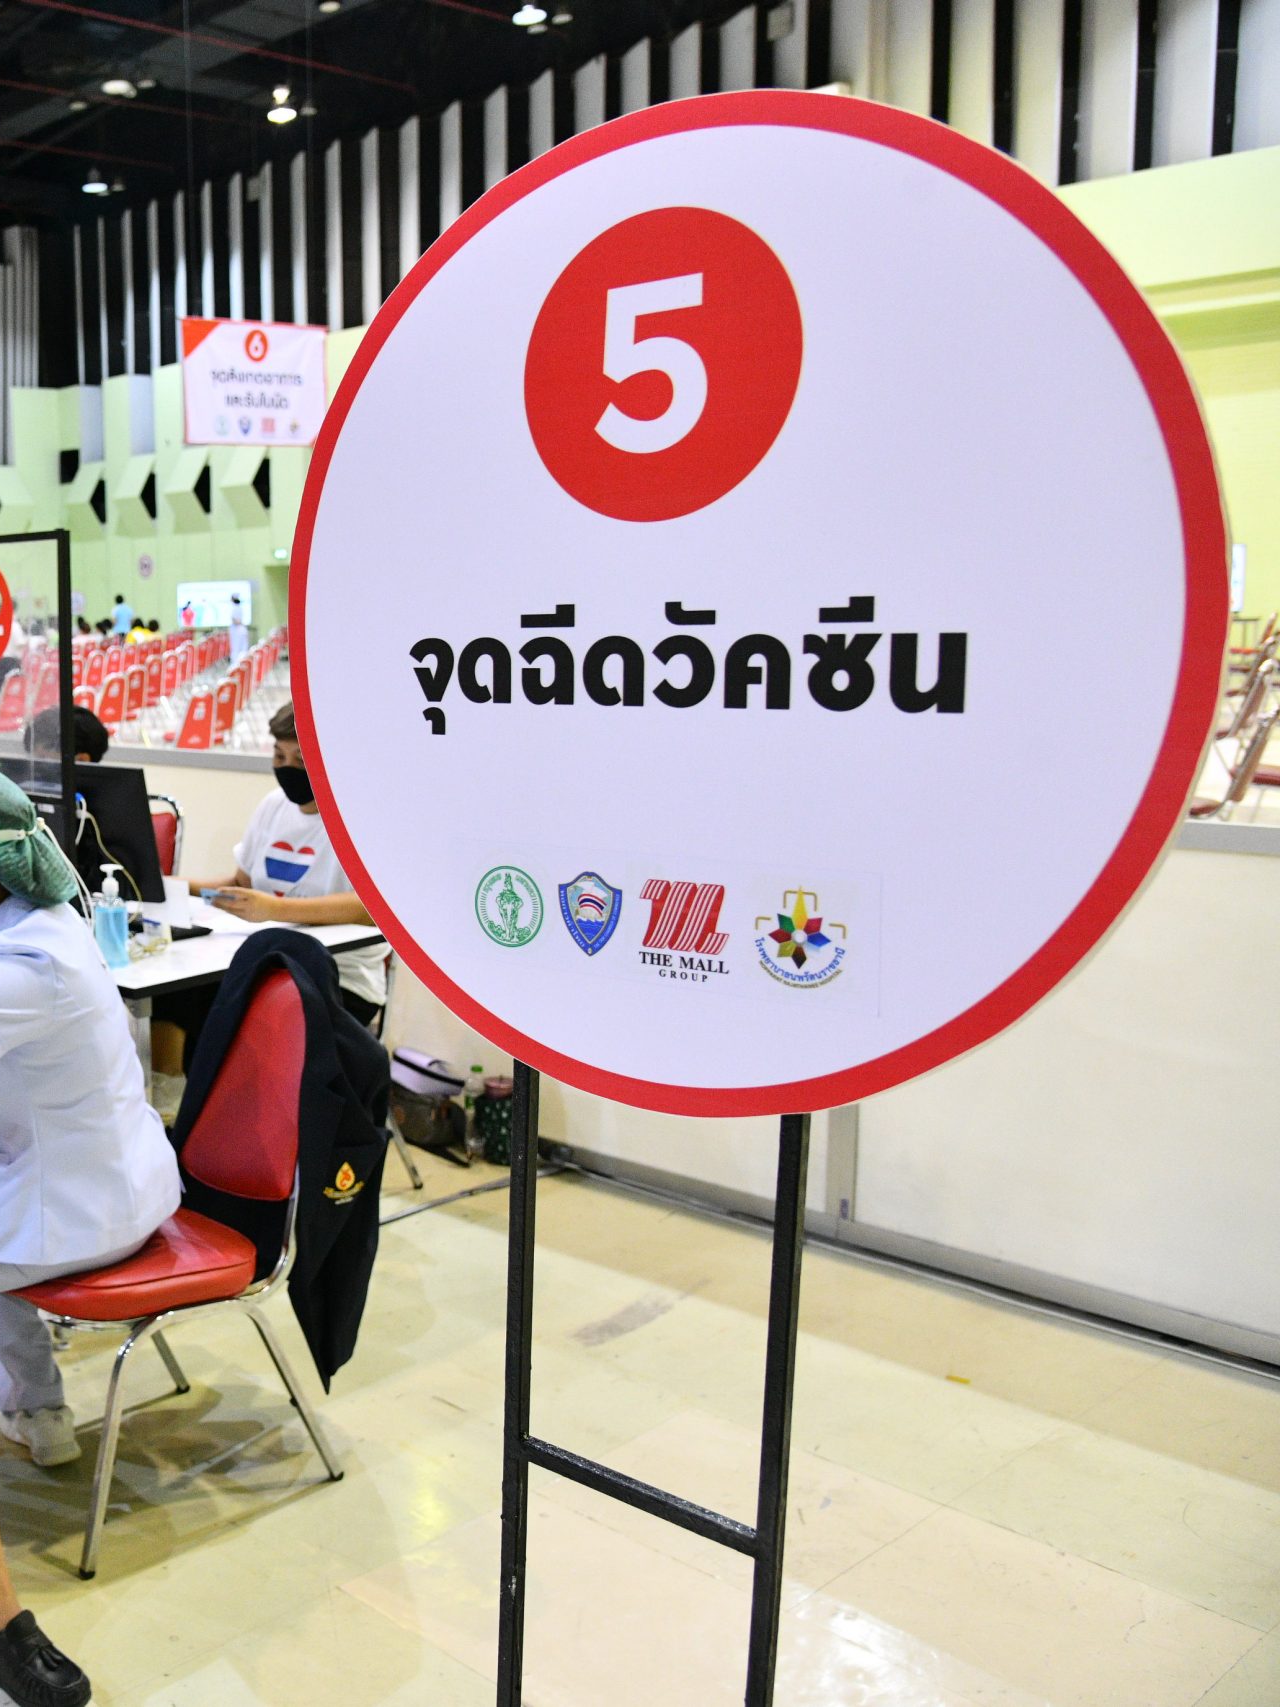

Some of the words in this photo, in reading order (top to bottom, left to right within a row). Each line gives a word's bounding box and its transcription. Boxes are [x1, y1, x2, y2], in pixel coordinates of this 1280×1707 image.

[249, 332, 264, 358] 6
[593, 271, 708, 454] 5
[409, 595, 968, 736] จุดฉีดวัคซีน
[638, 951, 673, 968] THE
[679, 956, 729, 975] MALL
[658, 969, 708, 983] GROUP
